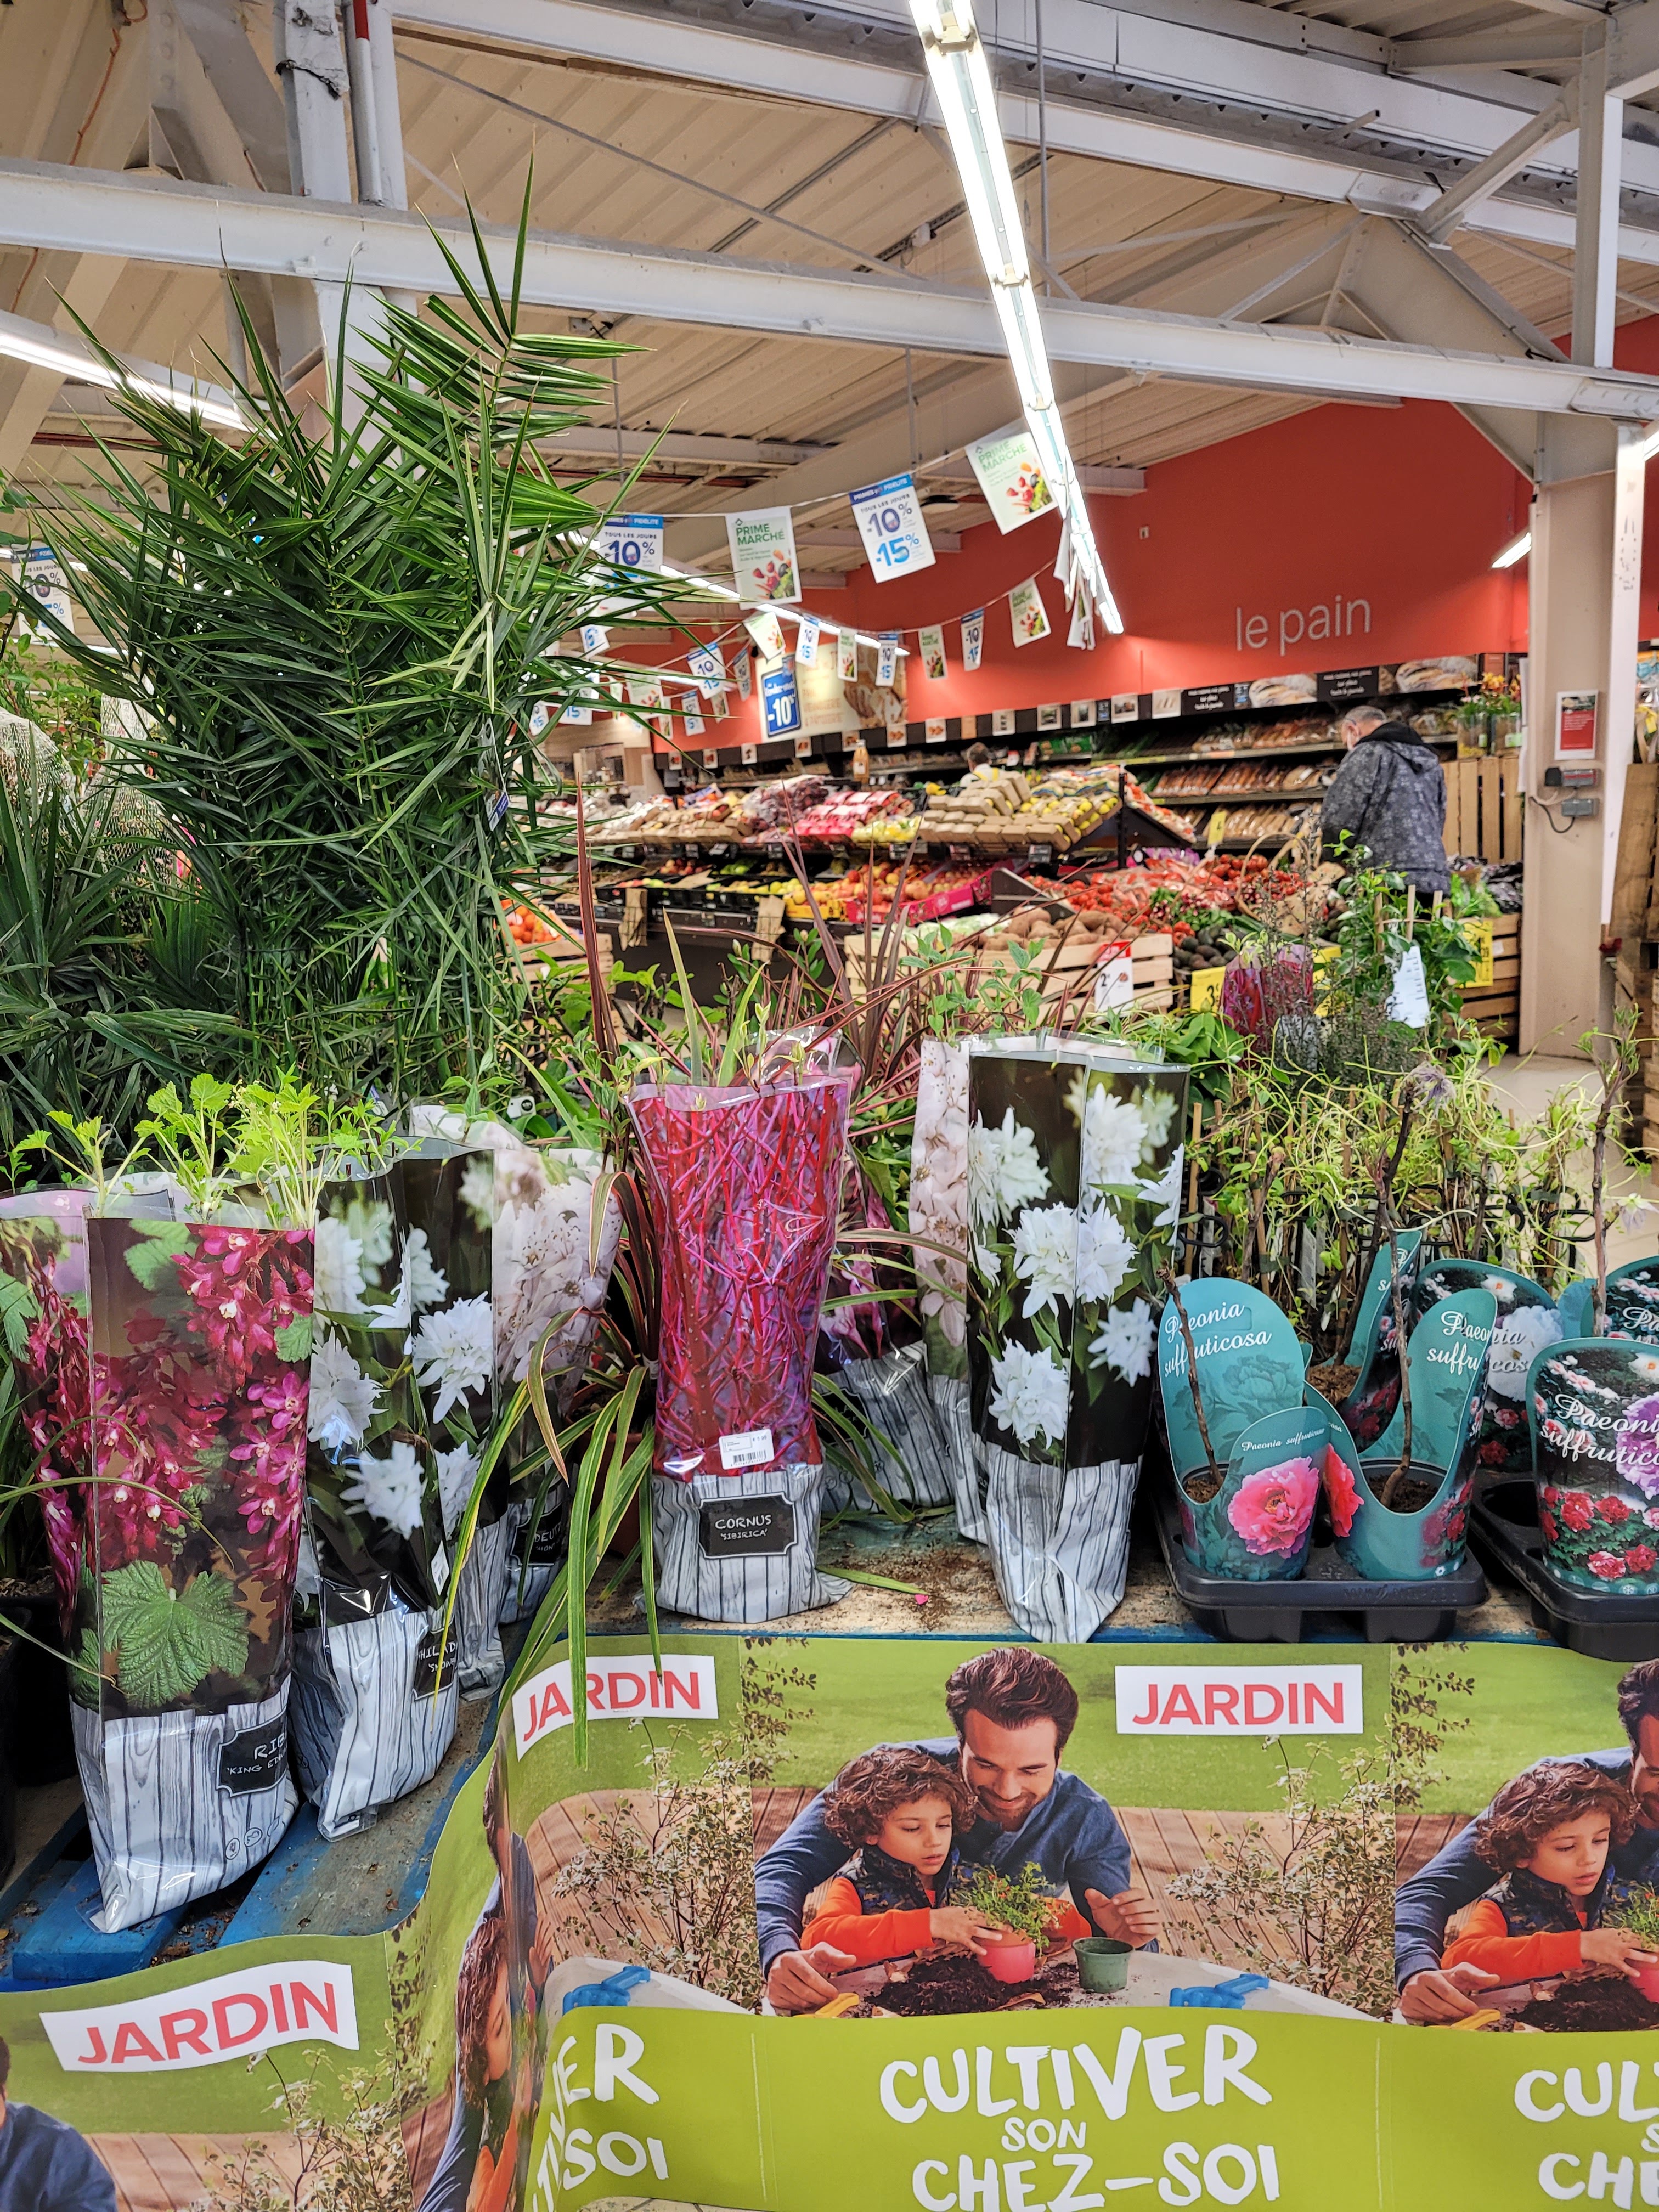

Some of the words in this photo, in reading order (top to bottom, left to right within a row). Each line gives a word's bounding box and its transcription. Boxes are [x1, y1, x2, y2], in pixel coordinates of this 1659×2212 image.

[736, 523, 770, 536] PRIME
[1236, 606, 1268, 651] le
[1280, 595, 1370, 657] pain
[1165, 1302, 1245, 1344] Peonia
[1164, 1331, 1272, 1378] suffuticosa
[715, 1514, 772, 1530] CORNUS
[523, 1670, 701, 1742] JARDIN
[1132, 1682, 1344, 1725] JARDIN
[78, 1982, 339, 2064] JARDIN
[879, 2024, 1273, 2124] CULTIVER
[1001, 2116, 1087, 2152] SON
